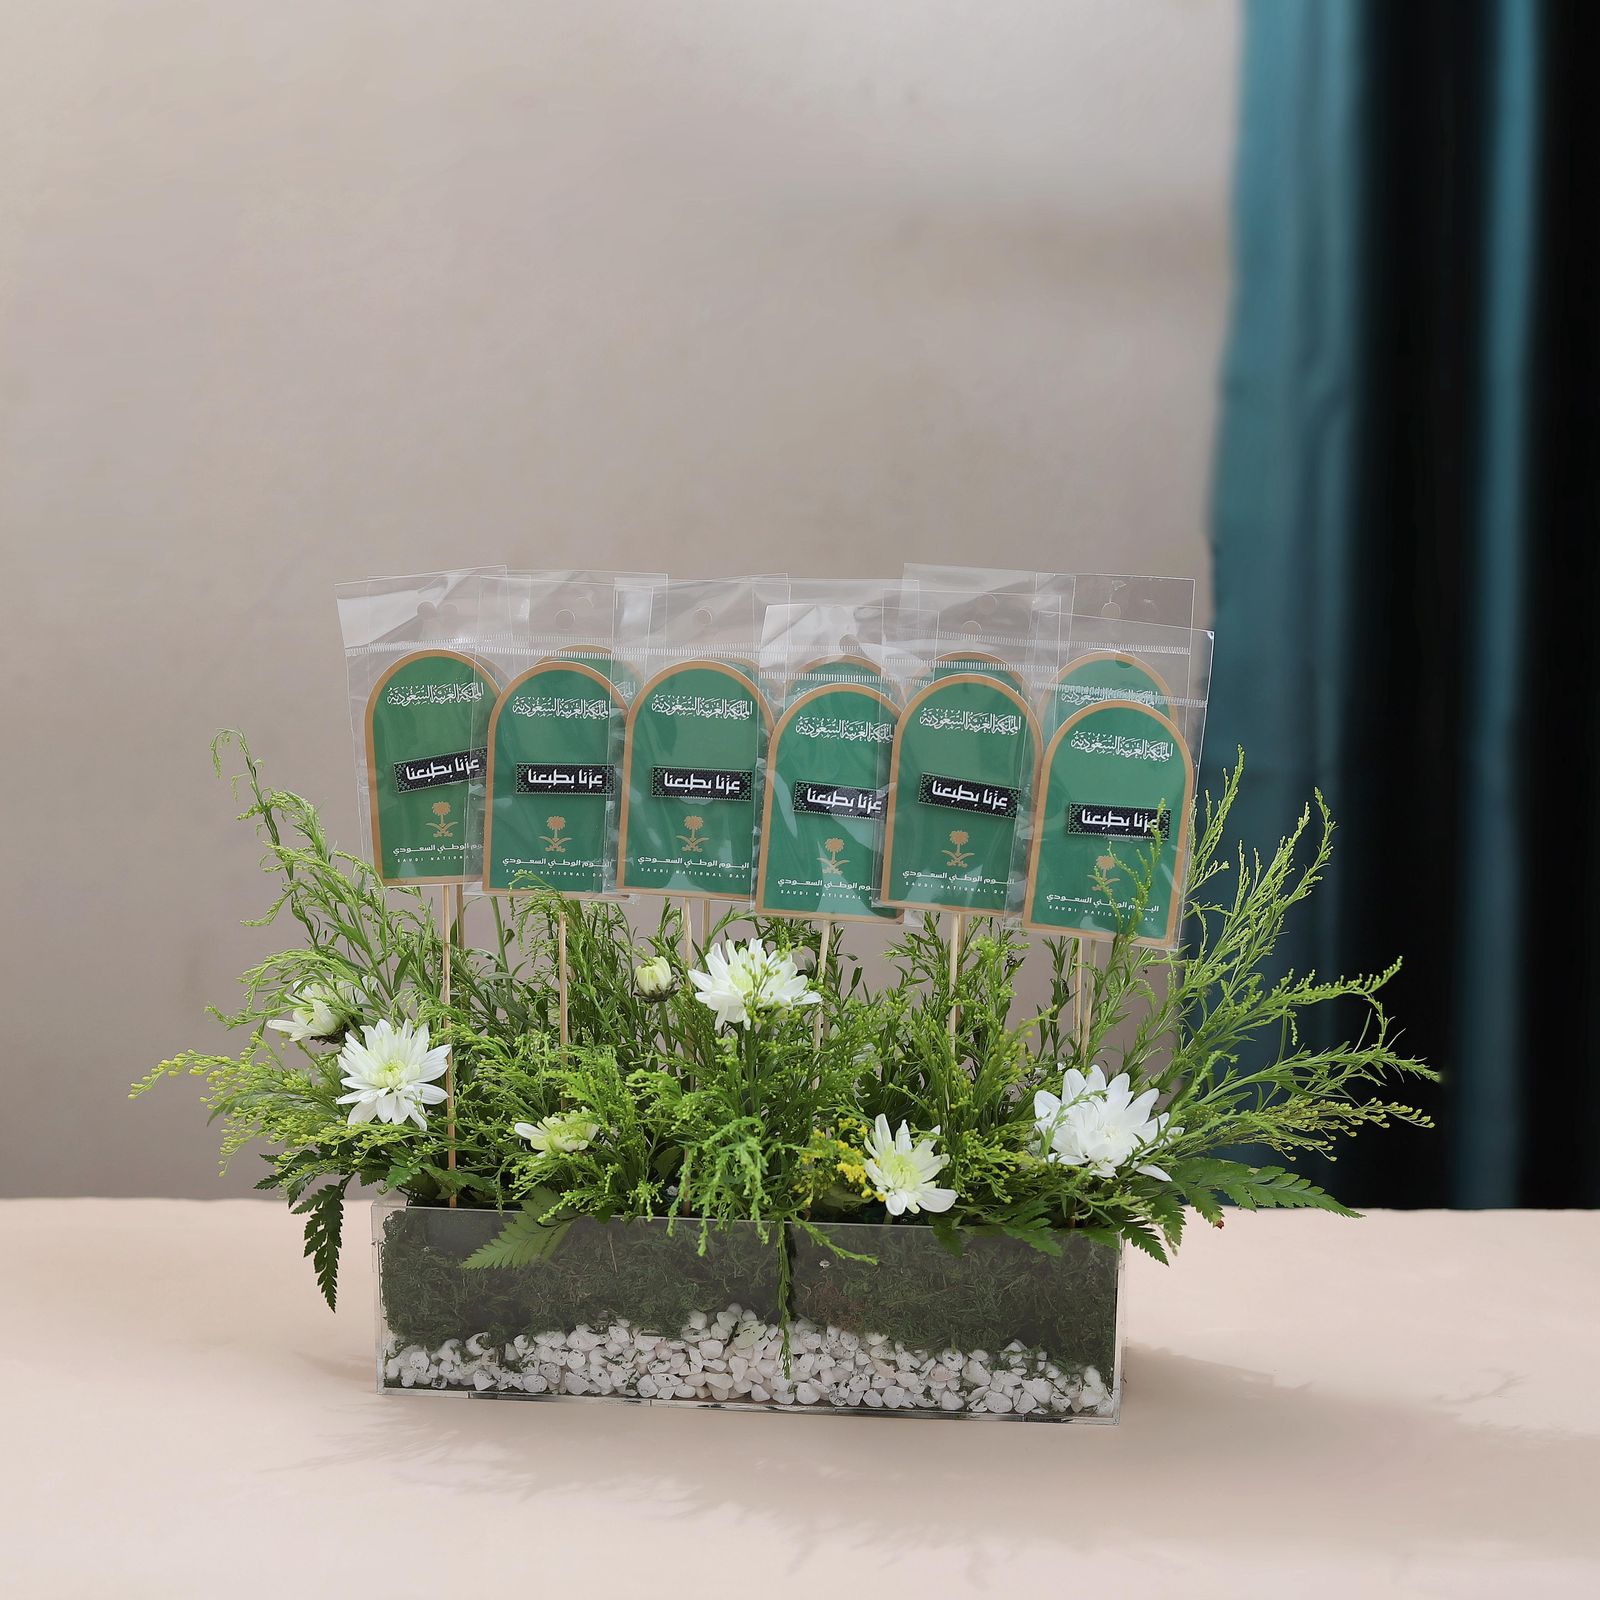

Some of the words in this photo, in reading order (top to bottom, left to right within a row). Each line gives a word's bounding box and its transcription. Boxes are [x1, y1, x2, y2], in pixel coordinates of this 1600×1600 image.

[405, 762, 452, 782] بطبعنا
[528, 769, 574, 789] بطبعنا
[664, 772, 712, 793] بطبعنا
[806, 787, 855, 812] بطبعنا
[931, 780, 980, 807] بطبعنا
[1081, 808, 1130, 832] بطبعنا
